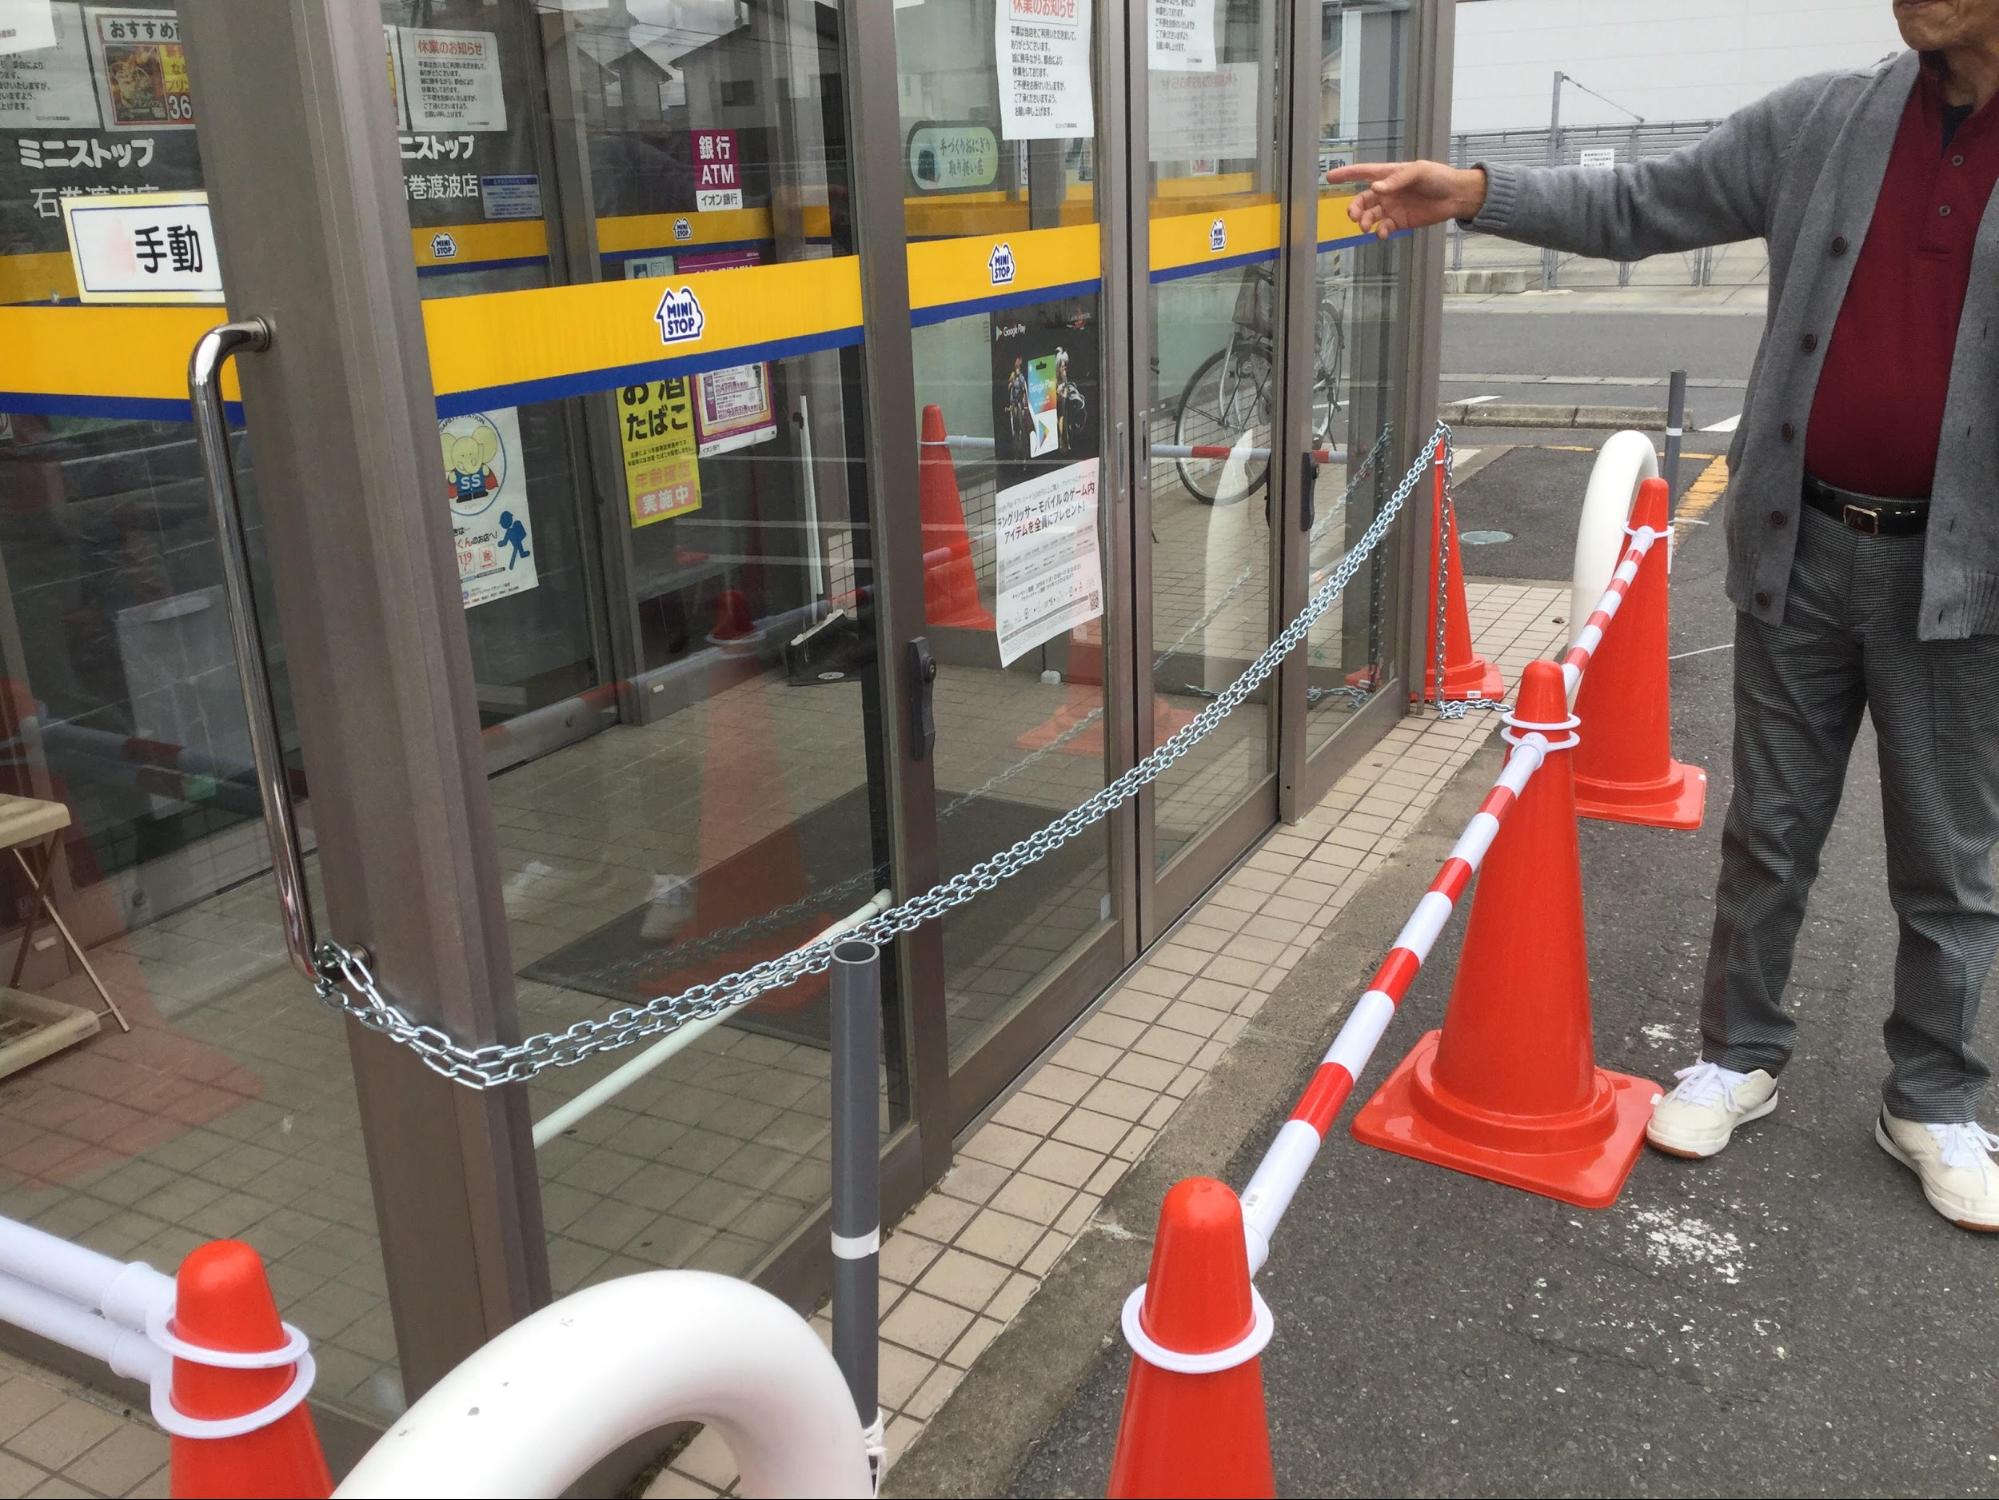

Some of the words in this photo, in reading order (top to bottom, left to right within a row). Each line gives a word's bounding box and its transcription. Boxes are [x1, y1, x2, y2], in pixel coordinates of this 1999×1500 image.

[417, 39, 483, 56] 休業のお知らせ
[18, 137, 155, 169] ミニストップ
[698, 135, 731, 160] 銀行
[701, 164, 735, 185] ATM
[700, 192, 738, 206] イオン銀行
[134, 224, 203, 273] 手動
[436, 239, 451, 248] MINI
[437, 247, 452, 255] STOP
[994, 256, 1009, 267] MINI
[995, 266, 1010, 279] STOP
[667, 302, 692, 318] MINI
[668, 317, 695, 335] STOP
[1003, 326, 1018, 338] Google
[1018, 323, 1026, 335] Play
[626, 403, 688, 442] たばこ
[461, 473, 481, 490] SS
[641, 485, 689, 514] 実施中
[998, 482, 1095, 530] ラングリッサーモバイルのゲーム内
[1004, 502, 1086, 544] アイテムを全員にプレゼント!
